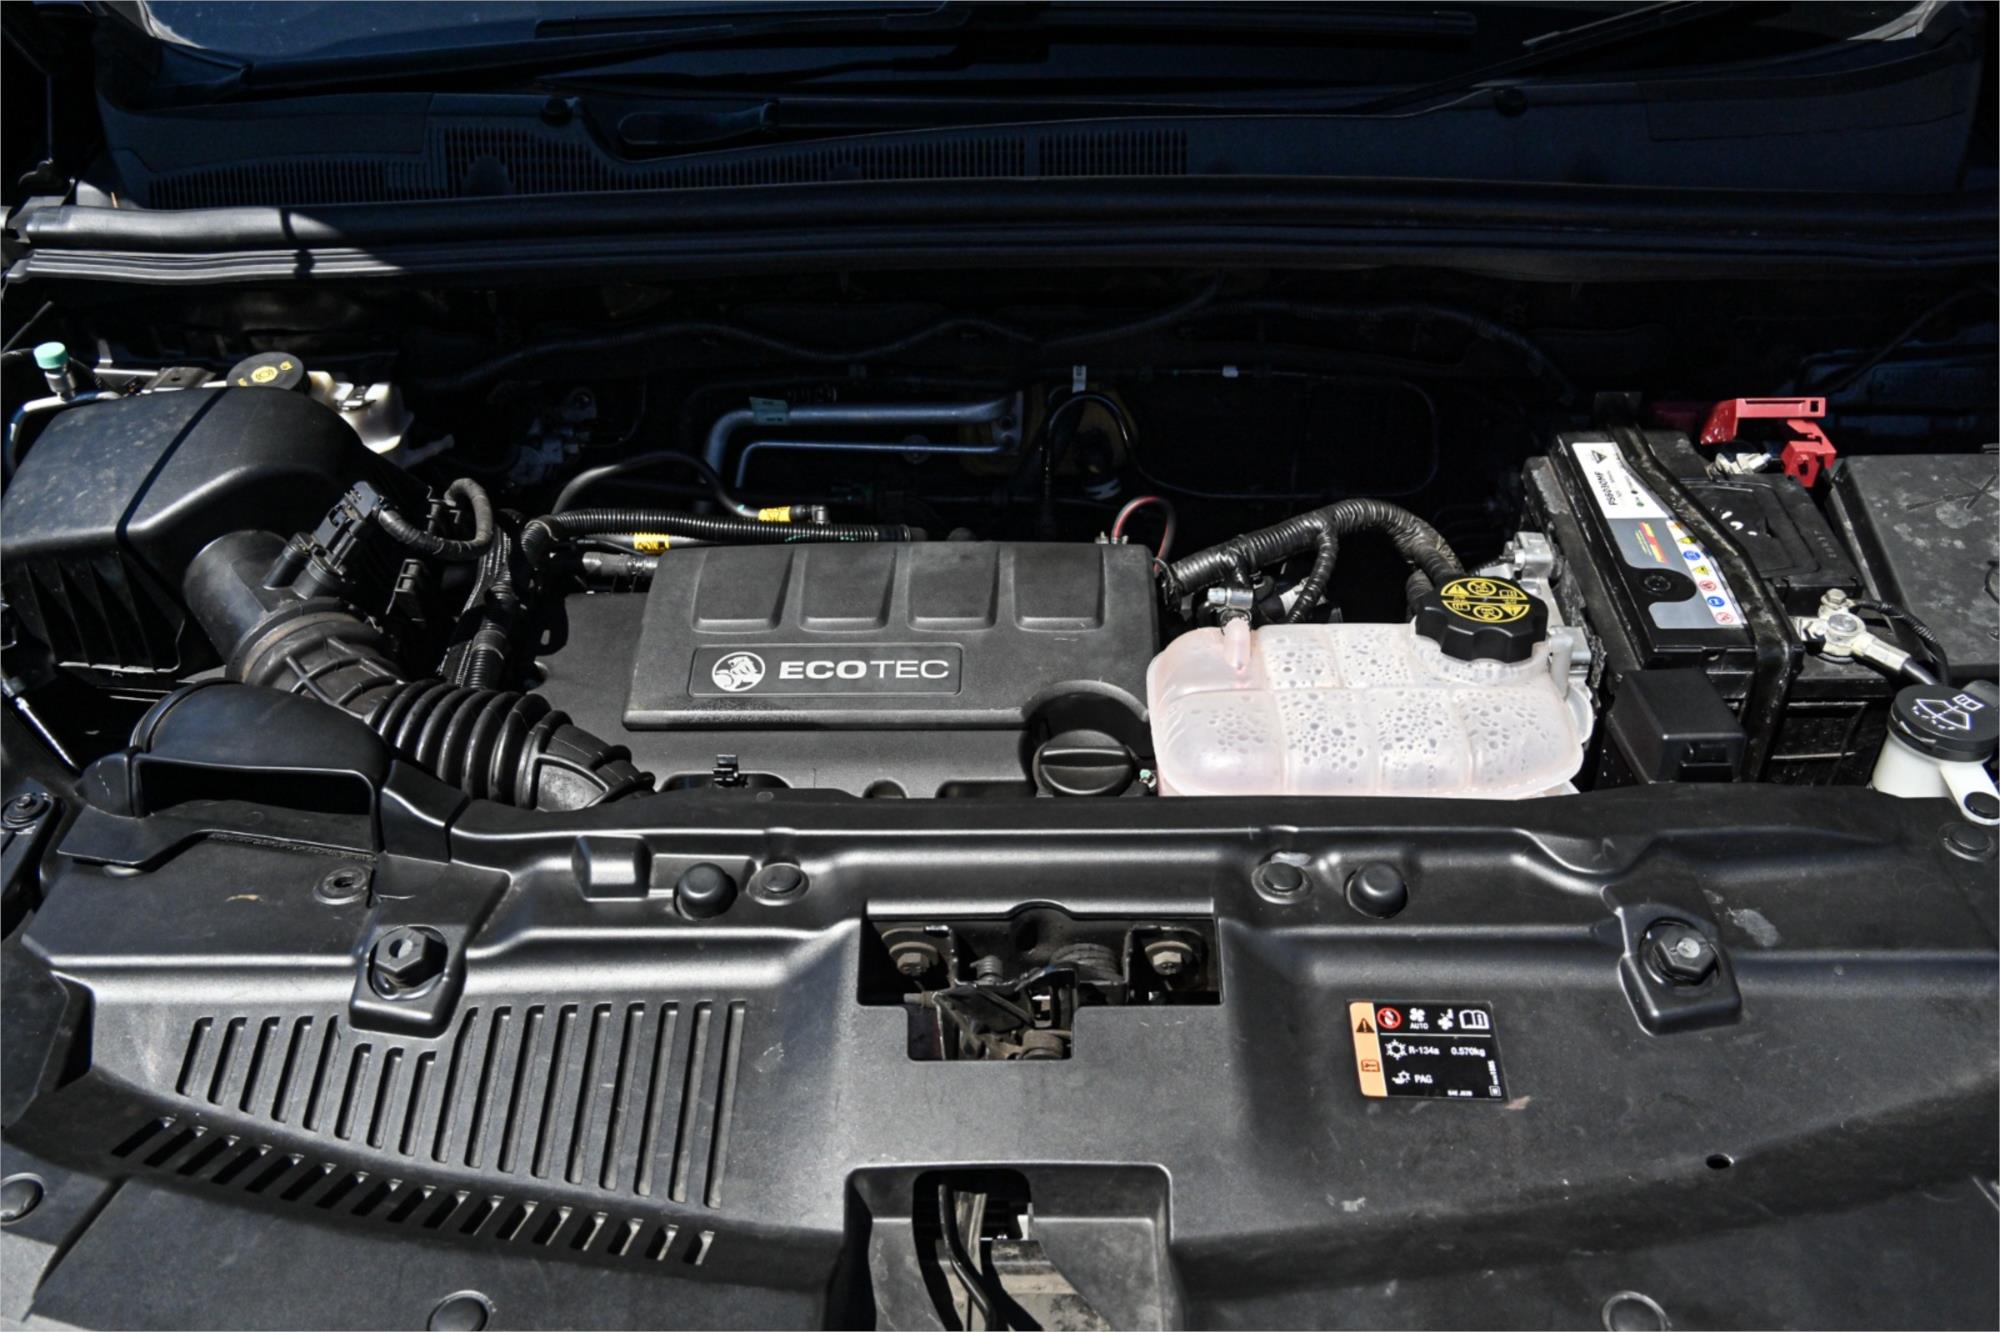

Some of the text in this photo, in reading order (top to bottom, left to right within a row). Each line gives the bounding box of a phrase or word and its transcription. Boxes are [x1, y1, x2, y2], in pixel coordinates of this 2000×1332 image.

[778, 660, 950, 679] ECOTEC
[1409, 1022, 1429, 1030] AUTO
[1408, 1045, 1440, 1055] R-134a
[1414, 1074, 1433, 1084] PAG
